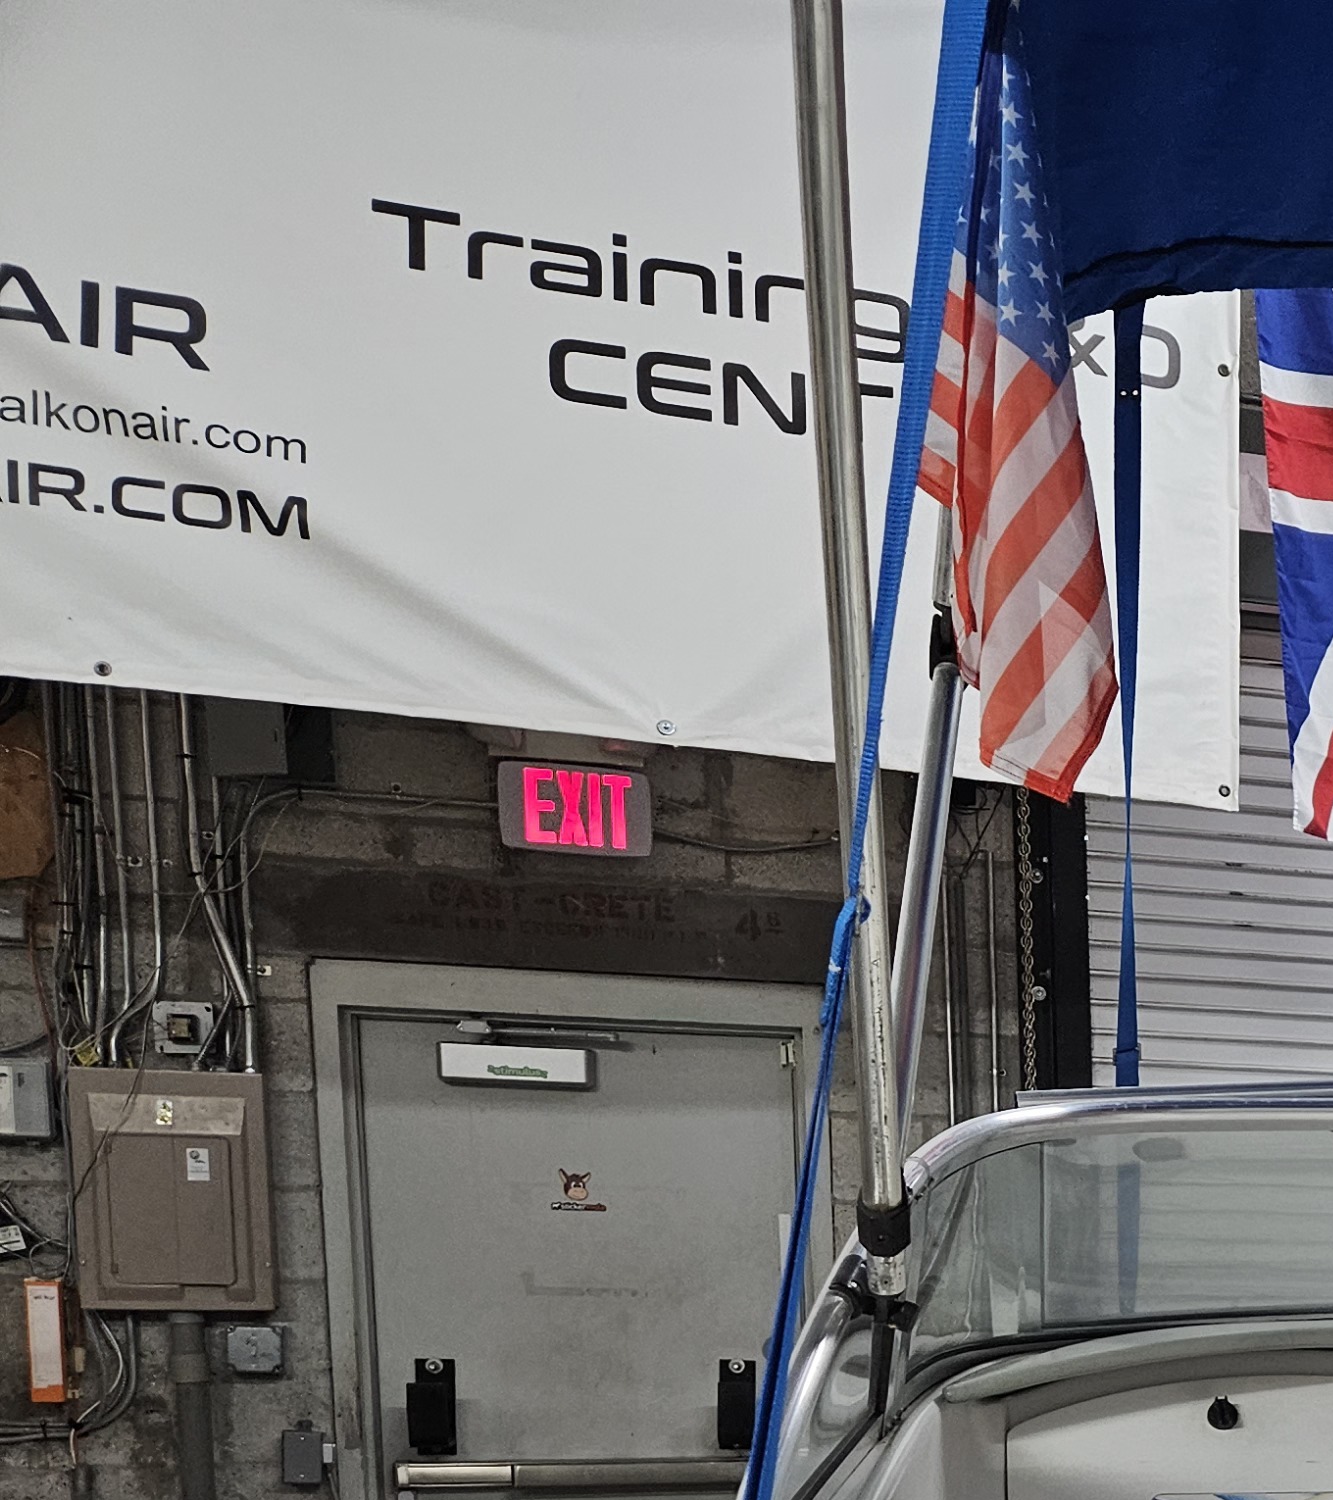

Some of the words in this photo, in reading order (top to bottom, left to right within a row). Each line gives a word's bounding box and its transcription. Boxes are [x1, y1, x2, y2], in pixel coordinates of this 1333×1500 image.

[0, 389, 307, 464] alkonair.com
[0, 458, 311, 540] IR.COM
[522, 767, 633, 850] EXIT
